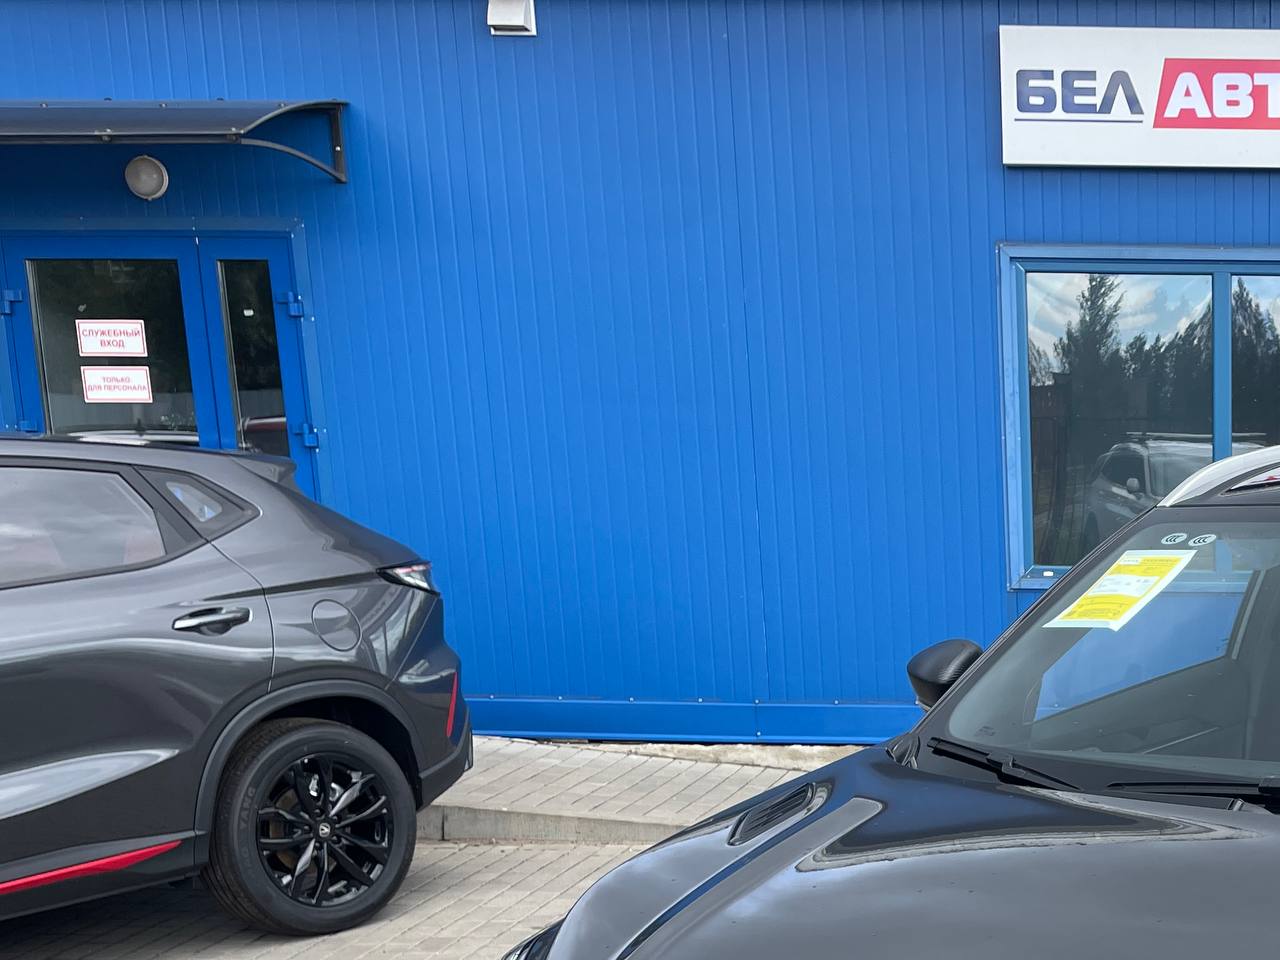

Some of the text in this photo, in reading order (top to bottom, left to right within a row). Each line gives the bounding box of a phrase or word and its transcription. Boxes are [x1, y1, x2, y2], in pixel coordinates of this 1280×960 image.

[1014, 69, 1144, 116] БЕЛ
[82, 328, 141, 338] СЛУЖЕБНЫЙ
[100, 340, 125, 348] ВХОД
